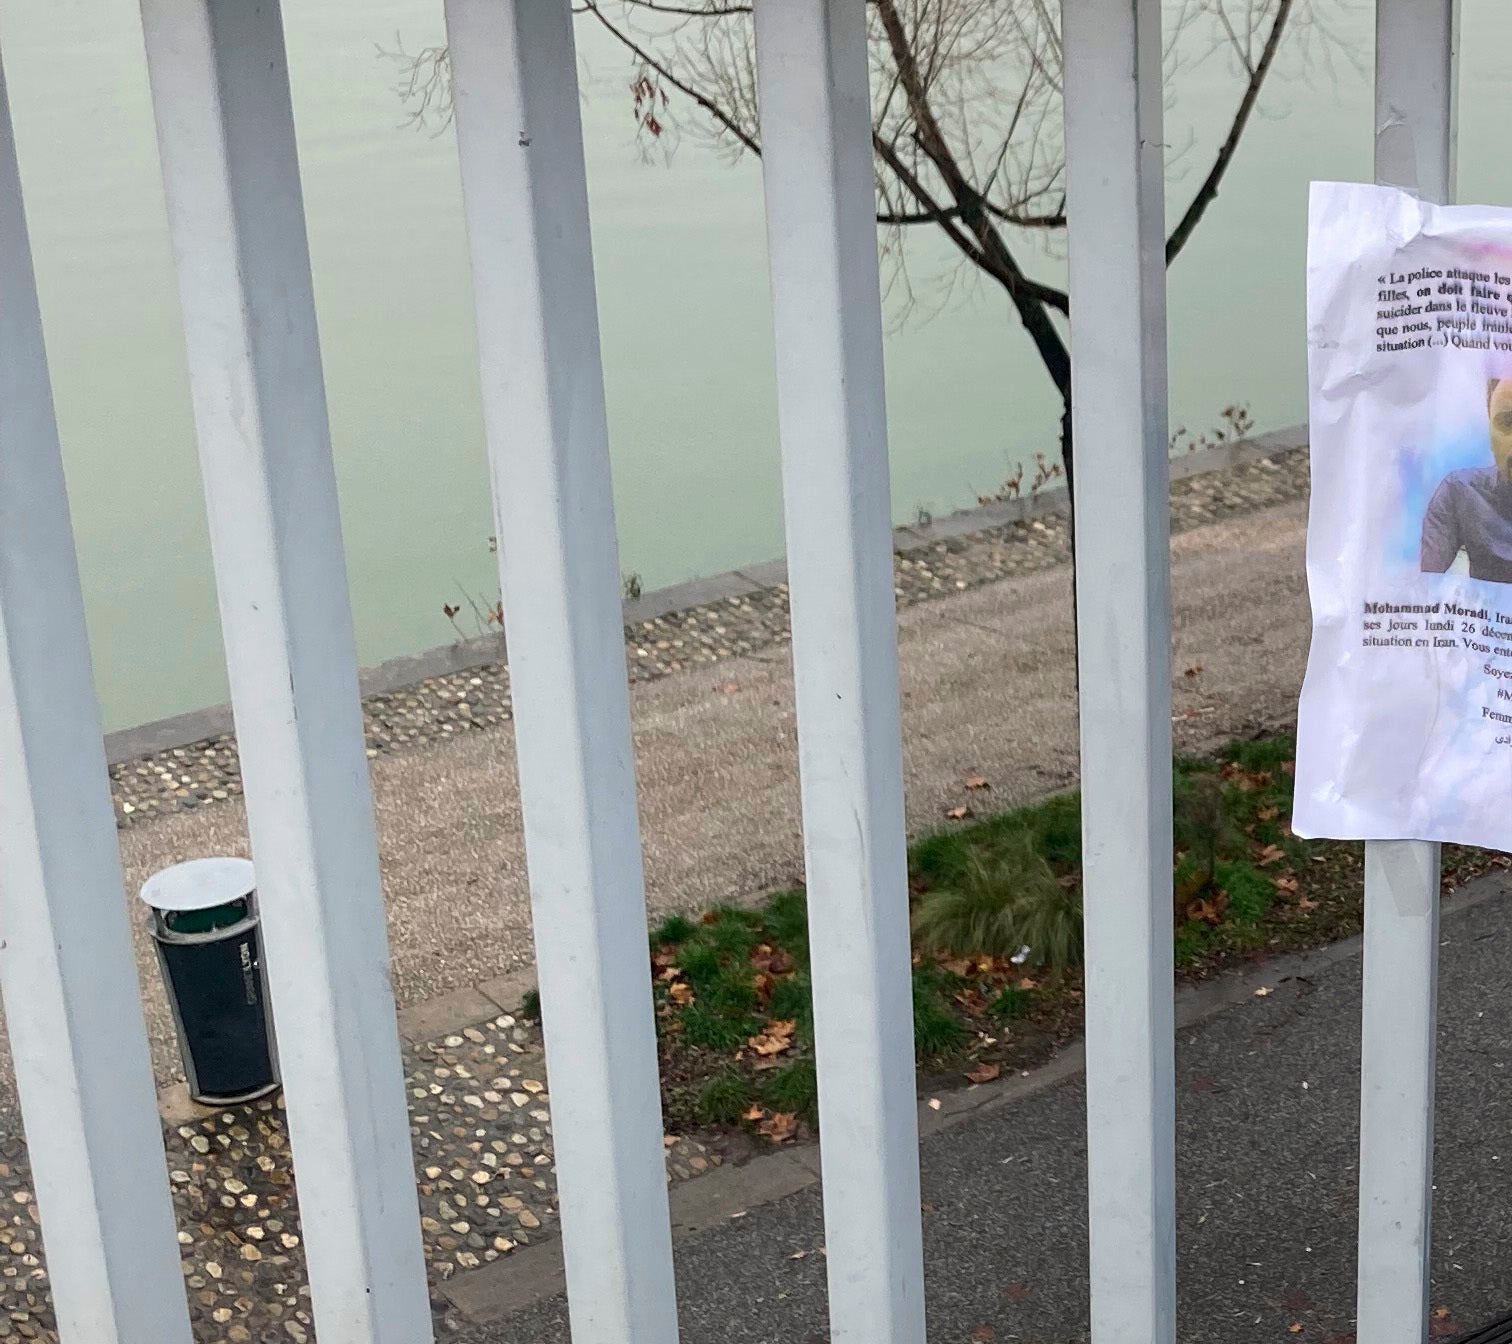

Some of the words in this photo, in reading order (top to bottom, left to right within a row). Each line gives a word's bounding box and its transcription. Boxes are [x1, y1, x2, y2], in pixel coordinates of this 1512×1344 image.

[1390, 273, 1405, 284] La
[1408, 267, 1442, 284] police
[1447, 268, 1490, 284] attaque
[1494, 272, 1510, 285] les
[1417, 287, 1431, 297] on
[1438, 282, 1463, 295] doit
[1471, 284, 1500, 299] faire
[1377, 305, 1423, 319] suicider
[1425, 301, 1452, 313] dans
[1456, 300, 1466, 312] le
[1471, 301, 1508, 317] fleuve
[1376, 327, 1398, 338] que
[1402, 320, 1432, 334] nous,
[1437, 317, 1476, 332] peuple
[1376, 338, 1425, 352] situation
[1451, 334, 1490, 350] Quand
[1364, 601, 1440, 614] Mohammad
[1364, 621, 1381, 630] ses
[1388, 619, 1418, 632] jours
[1425, 619, 1454, 631] lundi
[1461, 622, 1475, 633] 26
[1363, 635, 1412, 647] situation
[1415, 639, 1429, 647] en
[1463, 637, 1490, 653] Vous
